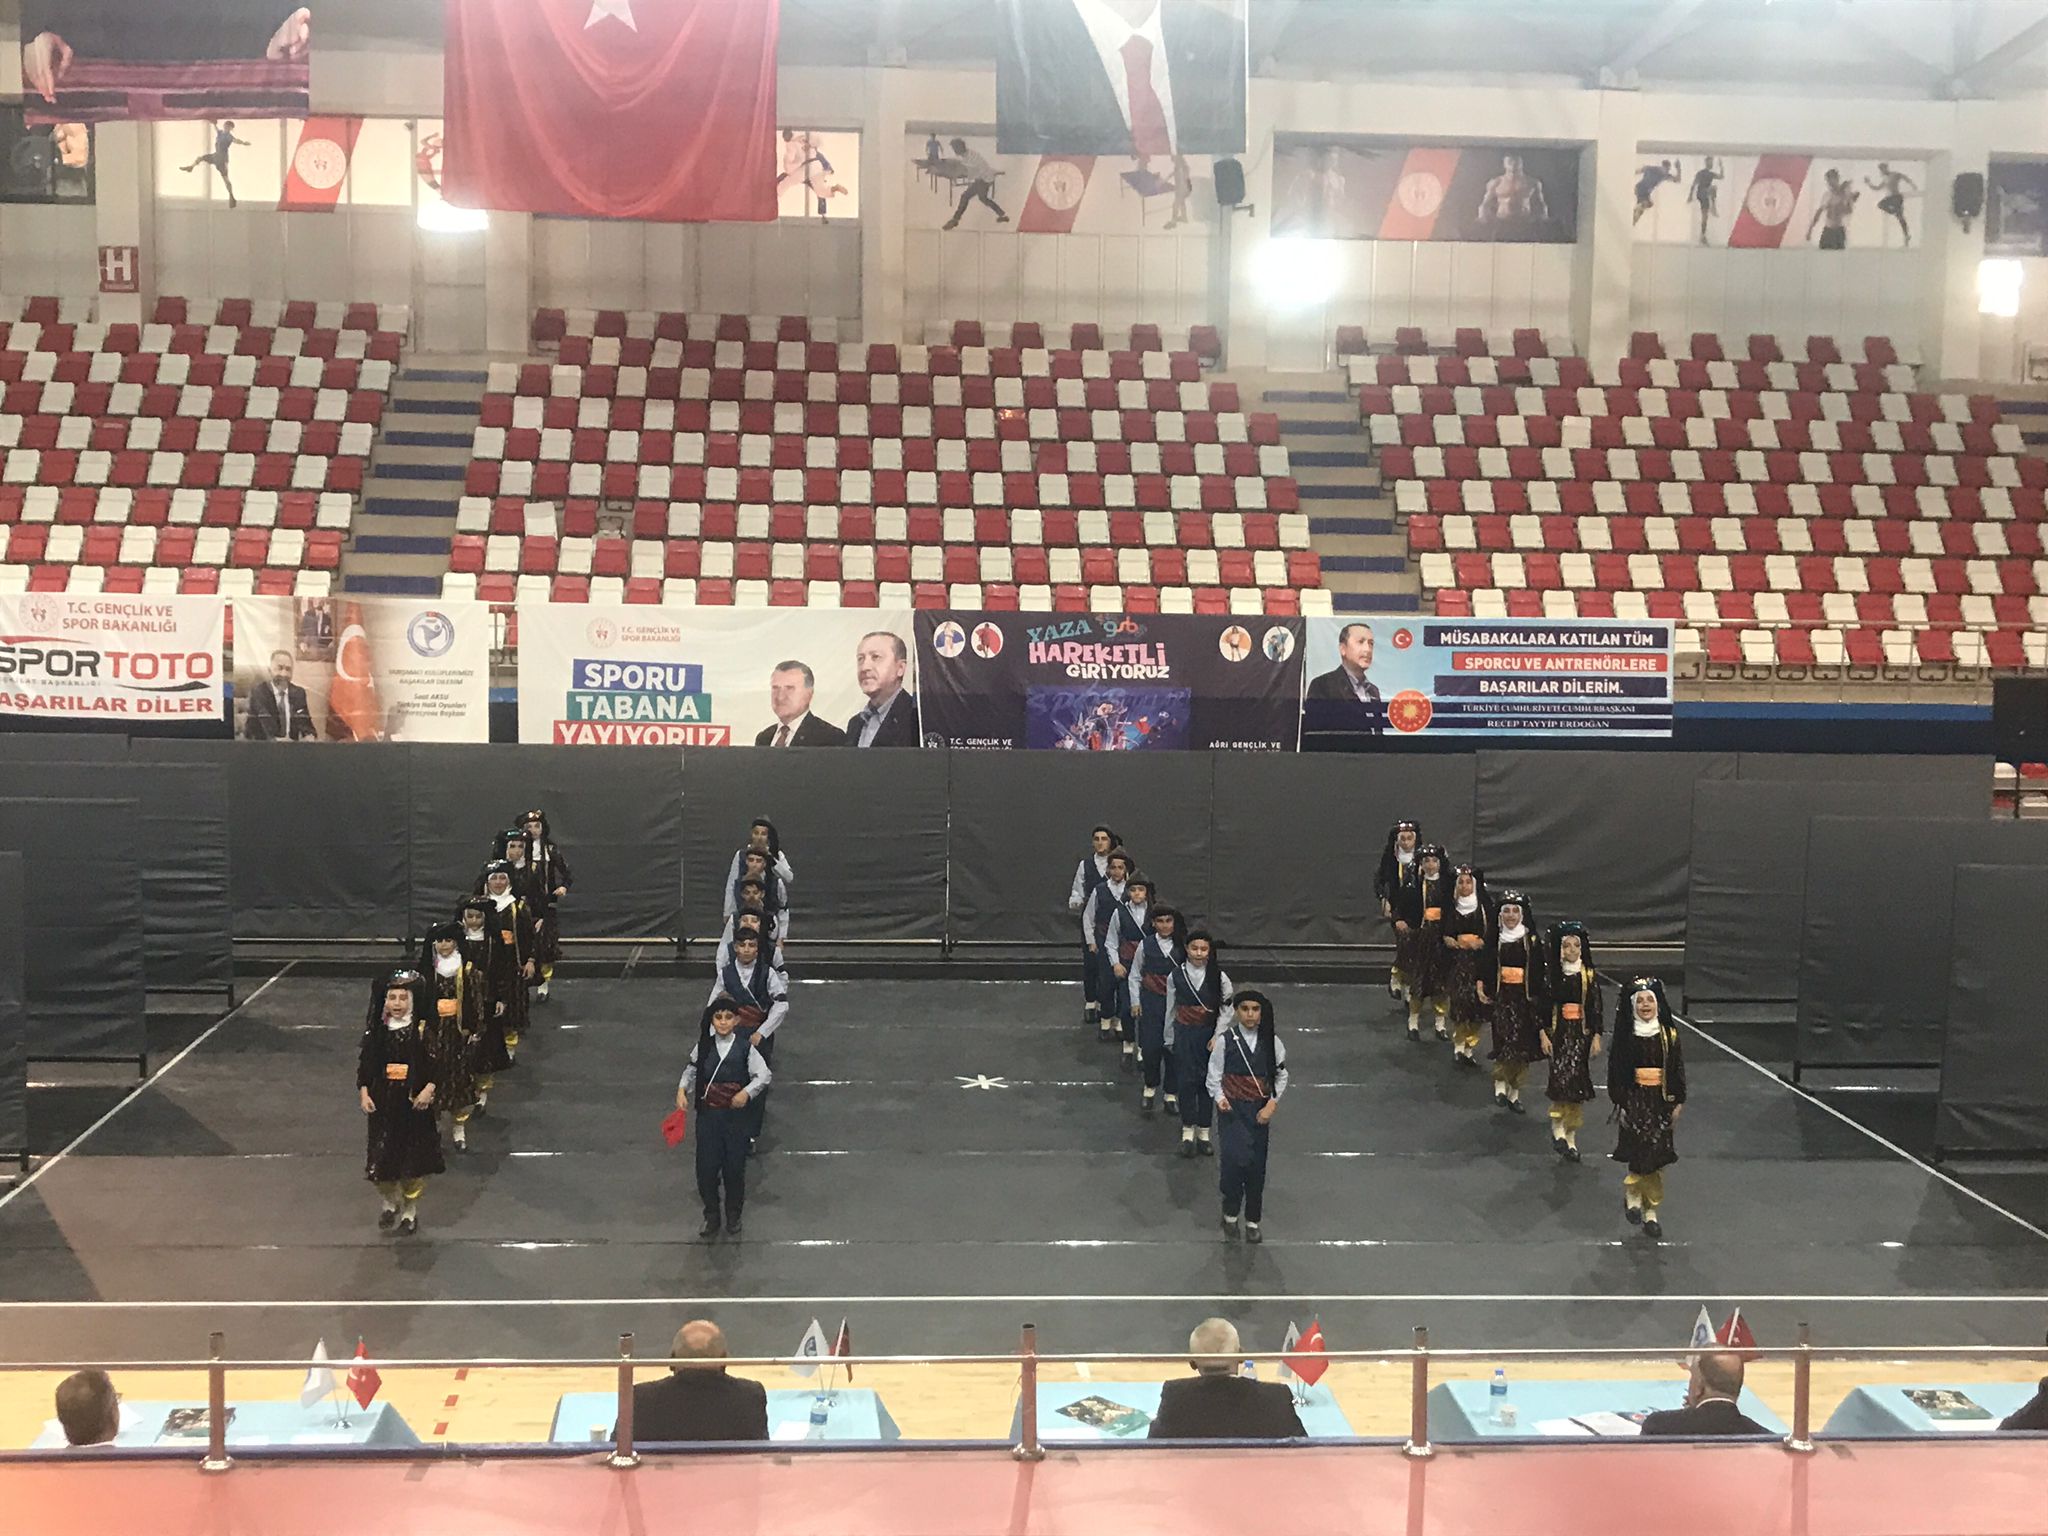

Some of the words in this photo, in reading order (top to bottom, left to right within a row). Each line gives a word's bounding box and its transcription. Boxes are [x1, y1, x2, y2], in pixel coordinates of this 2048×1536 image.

[67, 602, 91, 614] T.C.
[94, 602, 152, 618] GENÇLİK
[156, 605, 173, 616] VE
[63, 618, 99, 629] SPOR
[102, 618, 177, 632] BAKANLIĞI
[1027, 620, 1092, 642] YAZA
[1440, 629, 1557, 645] MÜSABAKALARA
[1560, 633, 1620, 645] KATILAN
[1624, 630, 1654, 646] TÜM
[1029, 641, 1167, 666] HAREKETLİ
[1465, 657, 1521, 670] SPORCU
[1524, 658, 1541, 669] VE
[1545, 654, 1657, 671] ANTRENÖRLERE
[584, 662, 686, 692] SPORU
[1066, 663, 1170, 680] GİRİYORUZ
[1480, 681, 1559, 696] BAŞARILAR
[1563, 678, 1624, 694] DİLERİM.
[137, 696, 213, 713] DİLER
[576, 695, 700, 720] TABANA
[1462, 703, 1500, 712] TÜRKİYE
[1562, 704, 1635, 713] CUMHURBAŞKANI
[1487, 720, 1520, 728] RECEP
[1522, 719, 1558, 728] TAYYİP
[1560, 719, 1609, 728] ERDOĞAN
[558, 724, 726, 746] YAYIYORUZ
[966, 738, 999, 746] GENÇLİK
[1232, 741, 1267, 749] GENÇLİK
